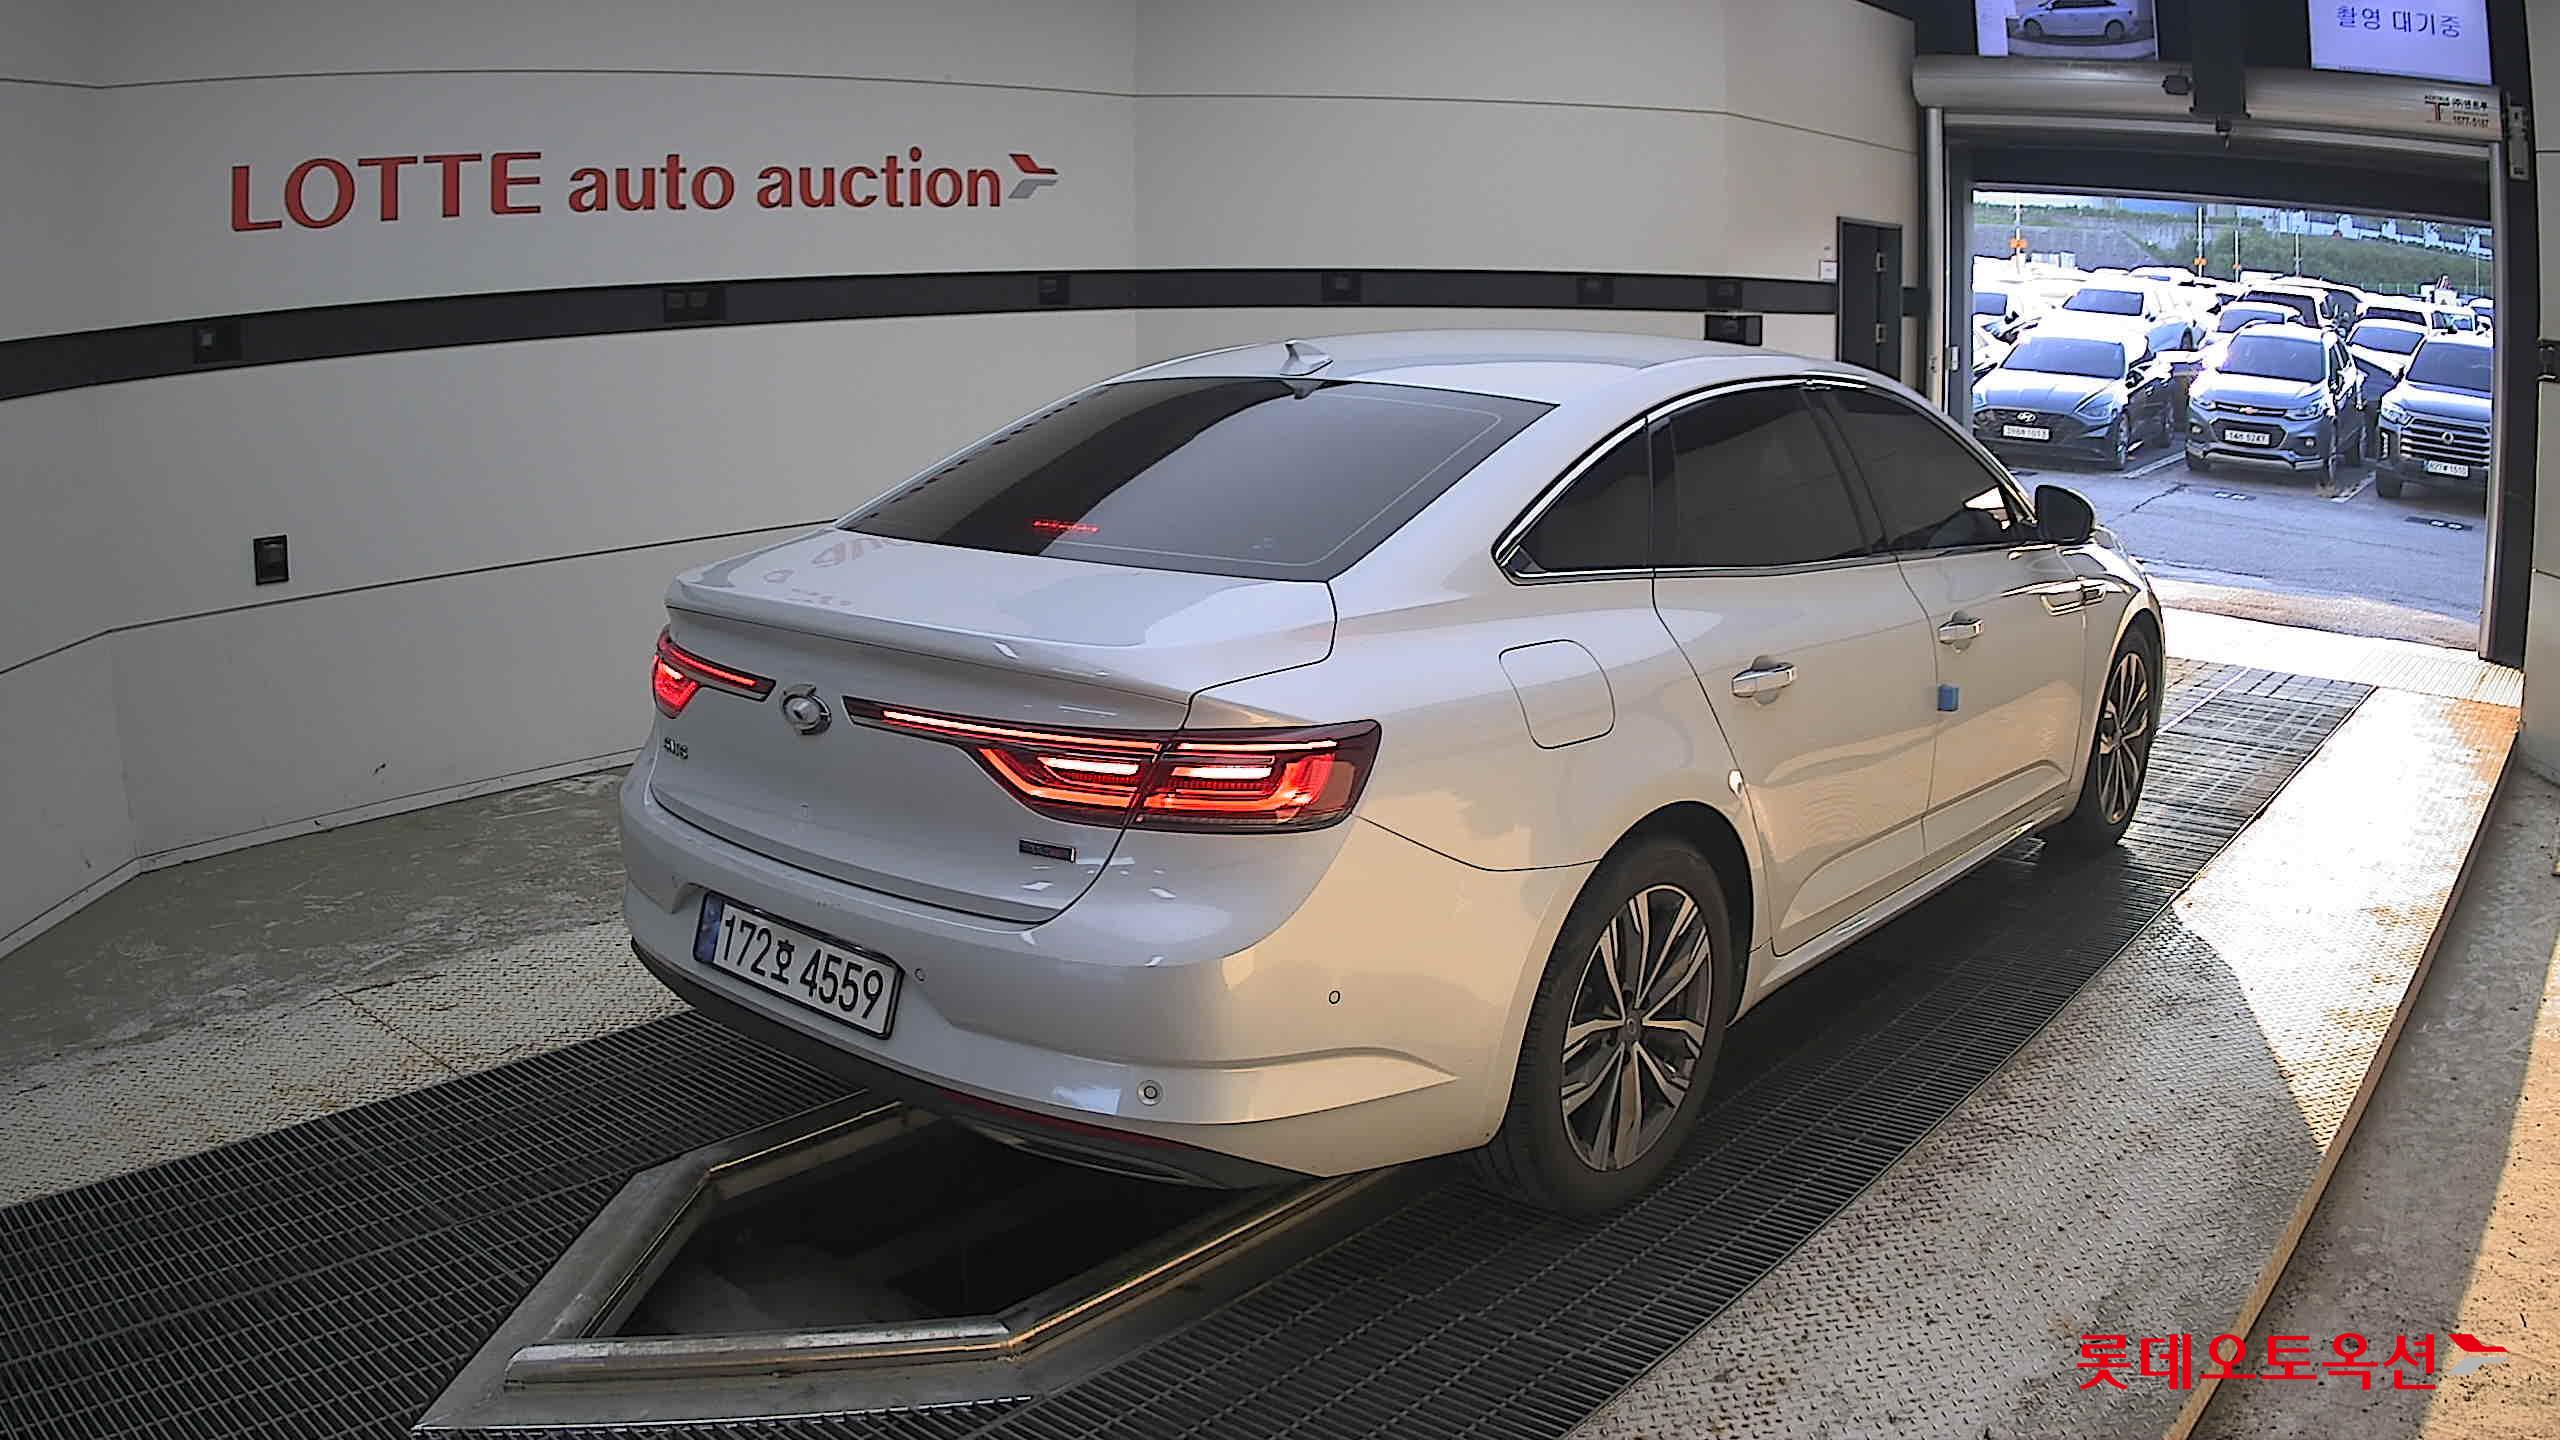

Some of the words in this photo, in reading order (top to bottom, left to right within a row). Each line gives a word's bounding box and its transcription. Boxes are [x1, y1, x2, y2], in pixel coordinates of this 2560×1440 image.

[2336, 5, 2382, 31] 촬영
[2392, 10, 2462, 39] 대기중
[231, 152, 541, 231] LOTTE
[568, 153, 736, 213] auto
[757, 147, 1002, 209] auction
[724, 914, 796, 986] 172호
[799, 947, 885, 1020] 4559
